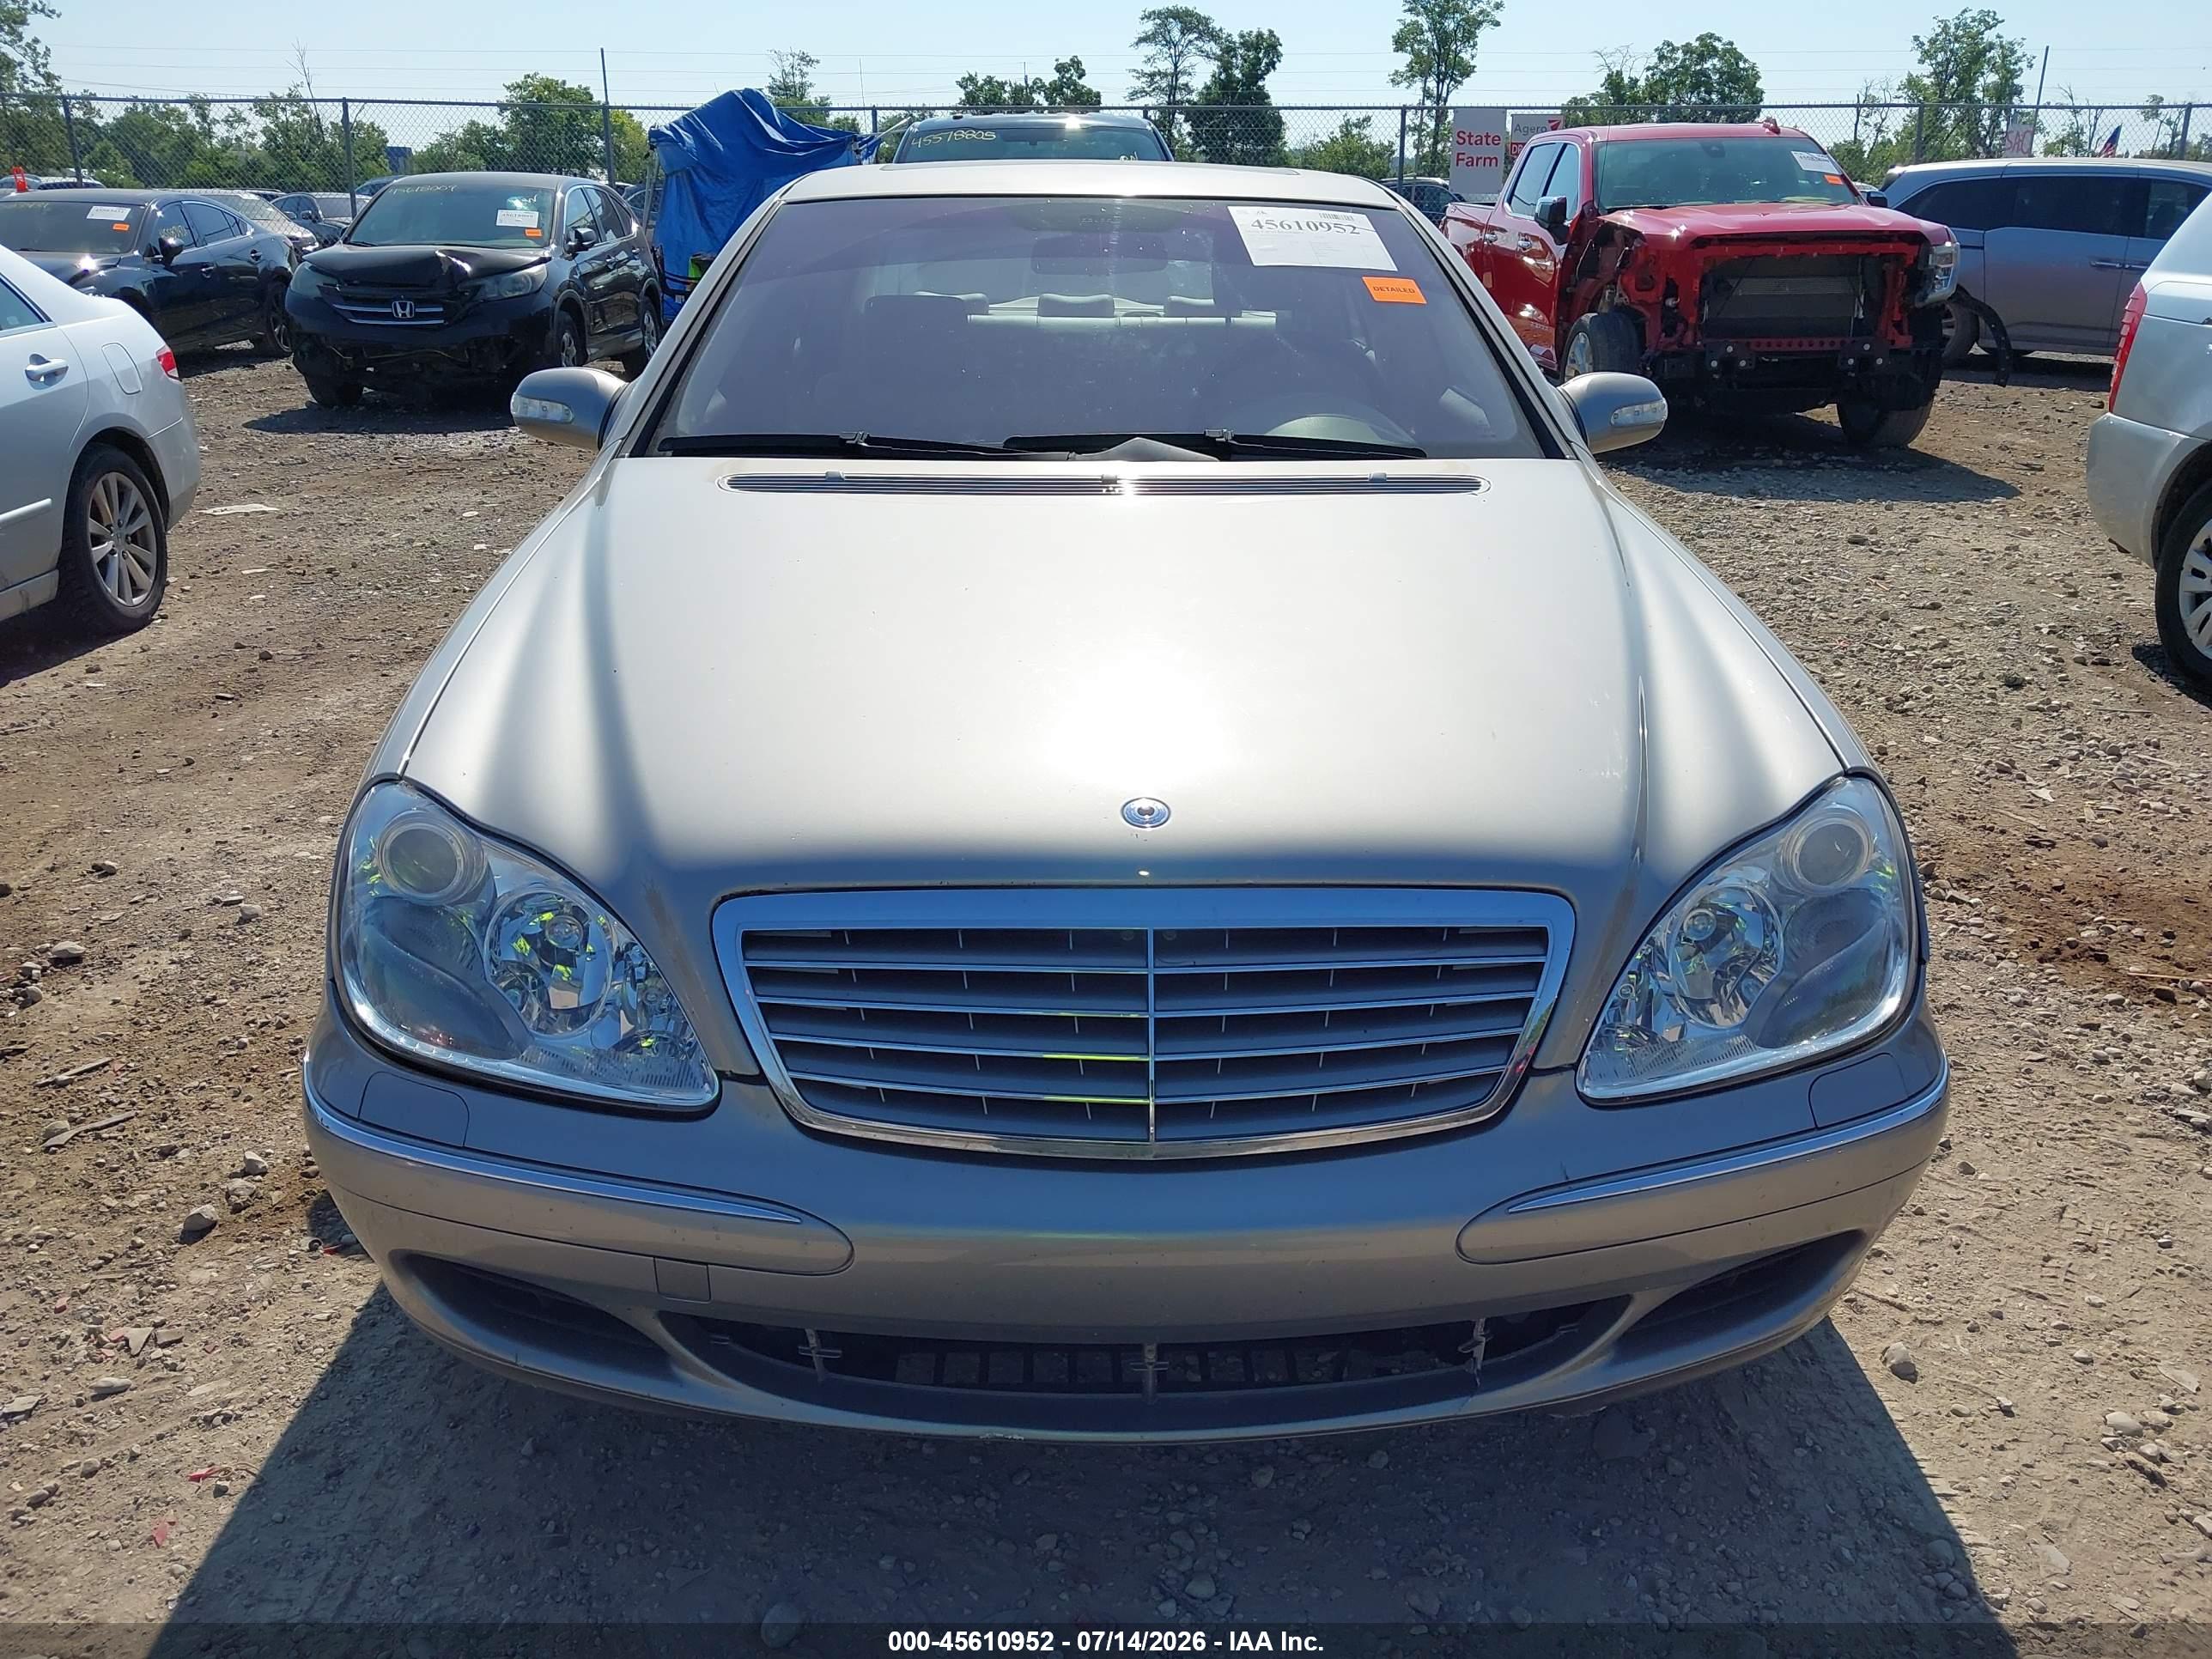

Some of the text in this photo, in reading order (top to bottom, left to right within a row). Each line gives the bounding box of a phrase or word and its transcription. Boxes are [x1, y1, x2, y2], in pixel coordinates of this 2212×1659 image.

[1455, 130, 1501, 146] State
[1513, 124, 1547, 136] Agero
[911, 130, 997, 148] 45578805
[1455, 152, 1498, 167] Farm
[1250, 218, 1360, 235] 45610952
